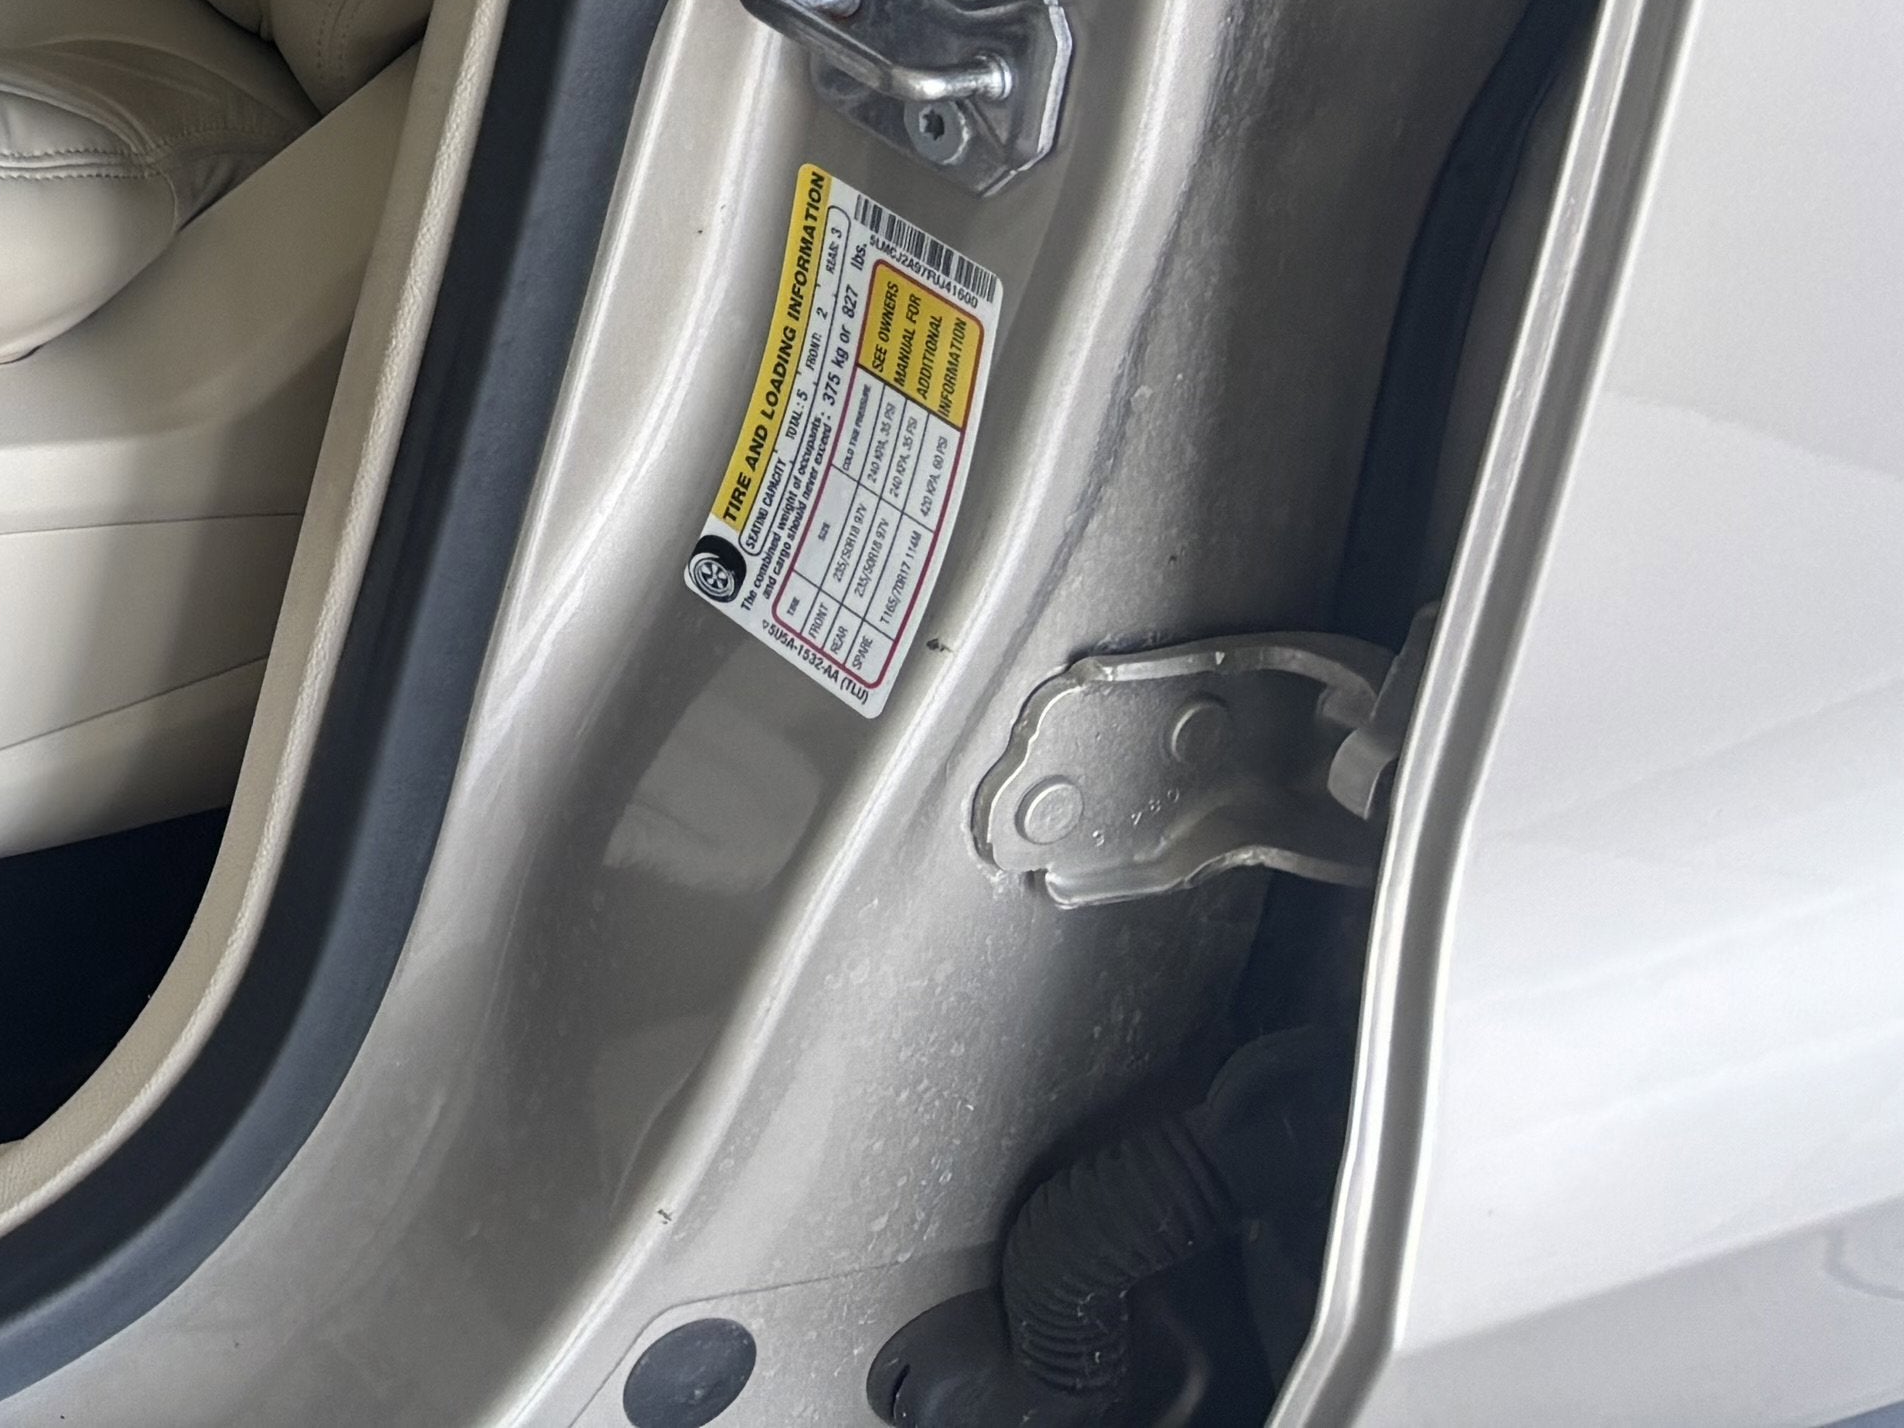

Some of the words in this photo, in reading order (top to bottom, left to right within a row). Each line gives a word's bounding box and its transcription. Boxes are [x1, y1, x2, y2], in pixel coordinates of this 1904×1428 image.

[830, 227, 842, 239] 3
[850, 243, 867, 271] lbs.
[815, 306, 828, 320] 2
[841, 283, 859, 319] 827
[878, 280, 899, 343] OWNERS
[722, 471, 752, 522] TIRE
[745, 424, 768, 472] AND
[760, 325, 796, 421] LOADING
[787, 171, 825, 322] INFORMATION
[839, 324, 851, 344] or
[893, 328, 915, 387] MANUAL
[905, 293, 921, 324] FOR
[830, 346, 849, 369] kg
[871, 343, 886, 373] SEE
[916, 315, 942, 400] ADDITIONAL
[937, 317, 967, 418] INFORMATION
[796, 388, 808, 402] 5
[822, 371, 841, 407] 375
[883, 401, 896, 422] PSI
[879, 421, 892, 437] 35
[905, 416, 918, 436] PSI
[902, 435, 914, 452] 35
[936, 435, 948, 455] PSI
[866, 461, 880, 484] 240
[932, 454, 943, 470] 60
[889, 475, 903, 499] 240
[740, 589, 757, 611] The
[753, 531, 781, 589] combined
[777, 490, 799, 531] weight
[792, 474, 802, 491] of
[797, 416, 822, 476] occupants
[745, 507, 768, 550] SEATING
[762, 457, 787, 508] CAPACITY
[919, 495, 932, 517] 420
[762, 575, 777, 600] and
[772, 541, 792, 576] cargo
[786, 499, 806, 541] should
[801, 466, 819, 501] never
[808, 602, 828, 640] FRONT
[830, 625, 848, 655] REAR
[852, 636, 873, 671] SPARE
